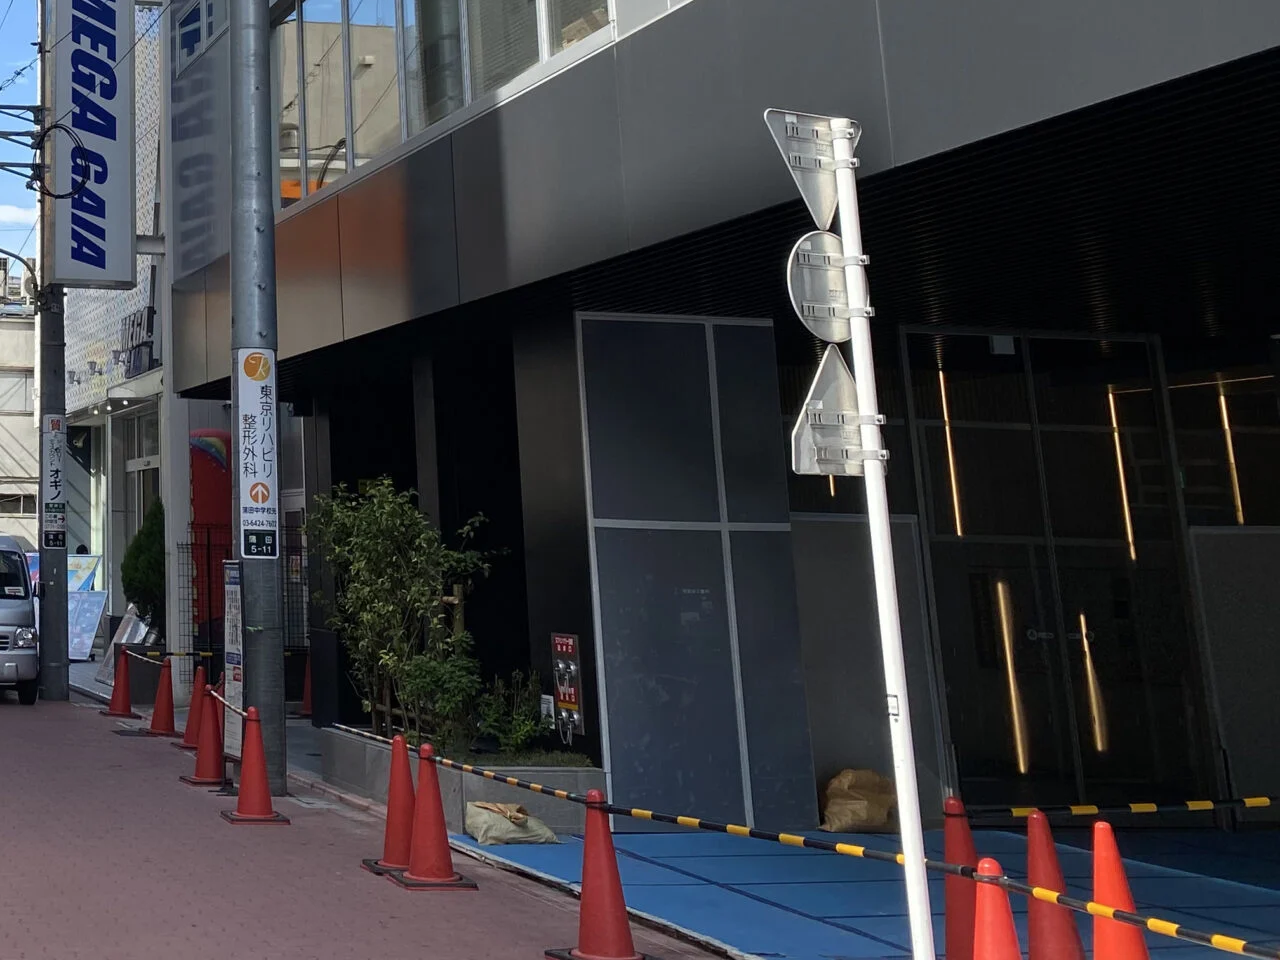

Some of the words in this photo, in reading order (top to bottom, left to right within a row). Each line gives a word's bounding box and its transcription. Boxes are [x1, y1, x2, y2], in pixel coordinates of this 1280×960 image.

[71, 145, 108, 269] GAIA
[242, 413, 258, 478] 整形外科
[259, 385, 274, 478] 東京リハビリ
[49, 468, 63, 501] オギノ
